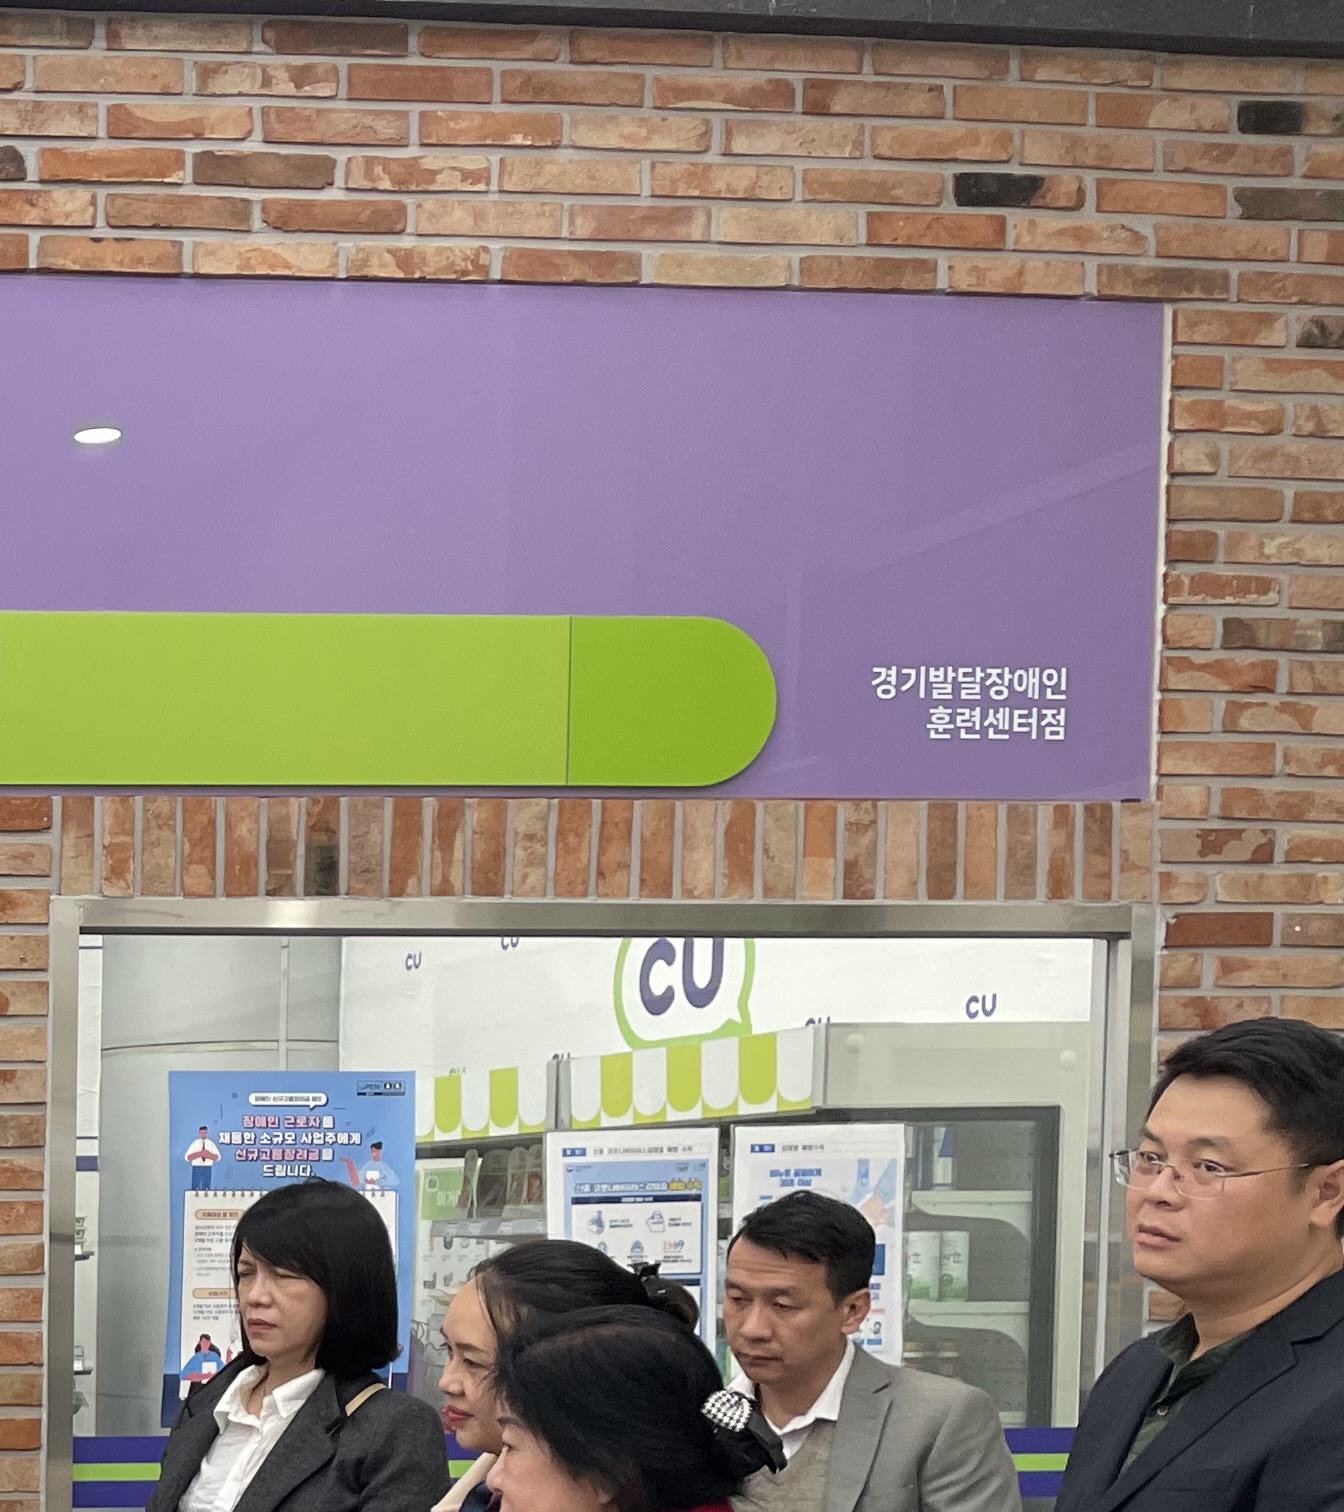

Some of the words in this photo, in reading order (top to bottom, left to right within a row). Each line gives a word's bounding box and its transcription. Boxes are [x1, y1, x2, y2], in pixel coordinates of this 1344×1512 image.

[871, 665, 1068, 700] 경기발달장애인
[926, 705, 1067, 740] 훈련센터점
[405, 951, 422, 971] CU
[639, 937, 725, 1016] CU
[965, 993, 997, 1019] CU
[242, 1115, 281, 1129] 장애인
[259, 1132, 297, 1145] 소규모
[300, 1131, 361, 1145] 사업주에게
